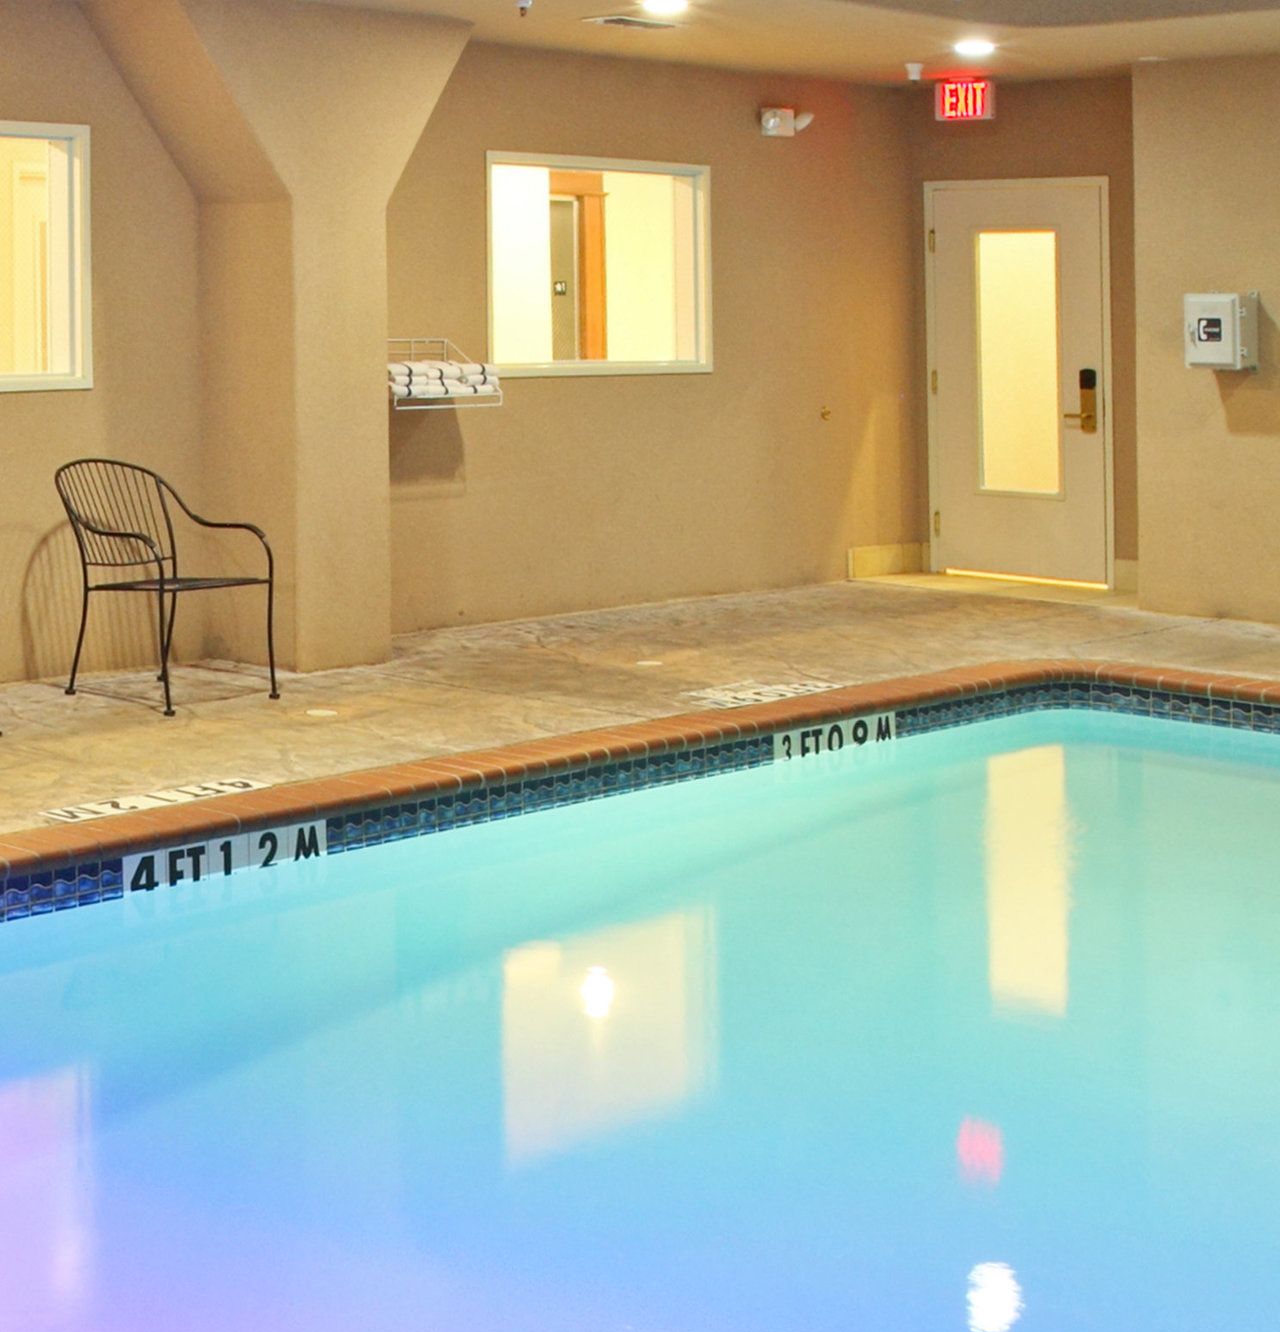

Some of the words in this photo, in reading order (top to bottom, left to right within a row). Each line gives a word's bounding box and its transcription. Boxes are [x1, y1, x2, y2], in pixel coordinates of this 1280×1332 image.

[944, 82, 986, 117] EXIT
[874, 714, 893, 743] M
[47, 806, 104, 821] M
[129, 854, 160, 891] 4
[168, 845, 207, 887] FT
[257, 831, 279, 868] 2
[293, 825, 321, 862] M
